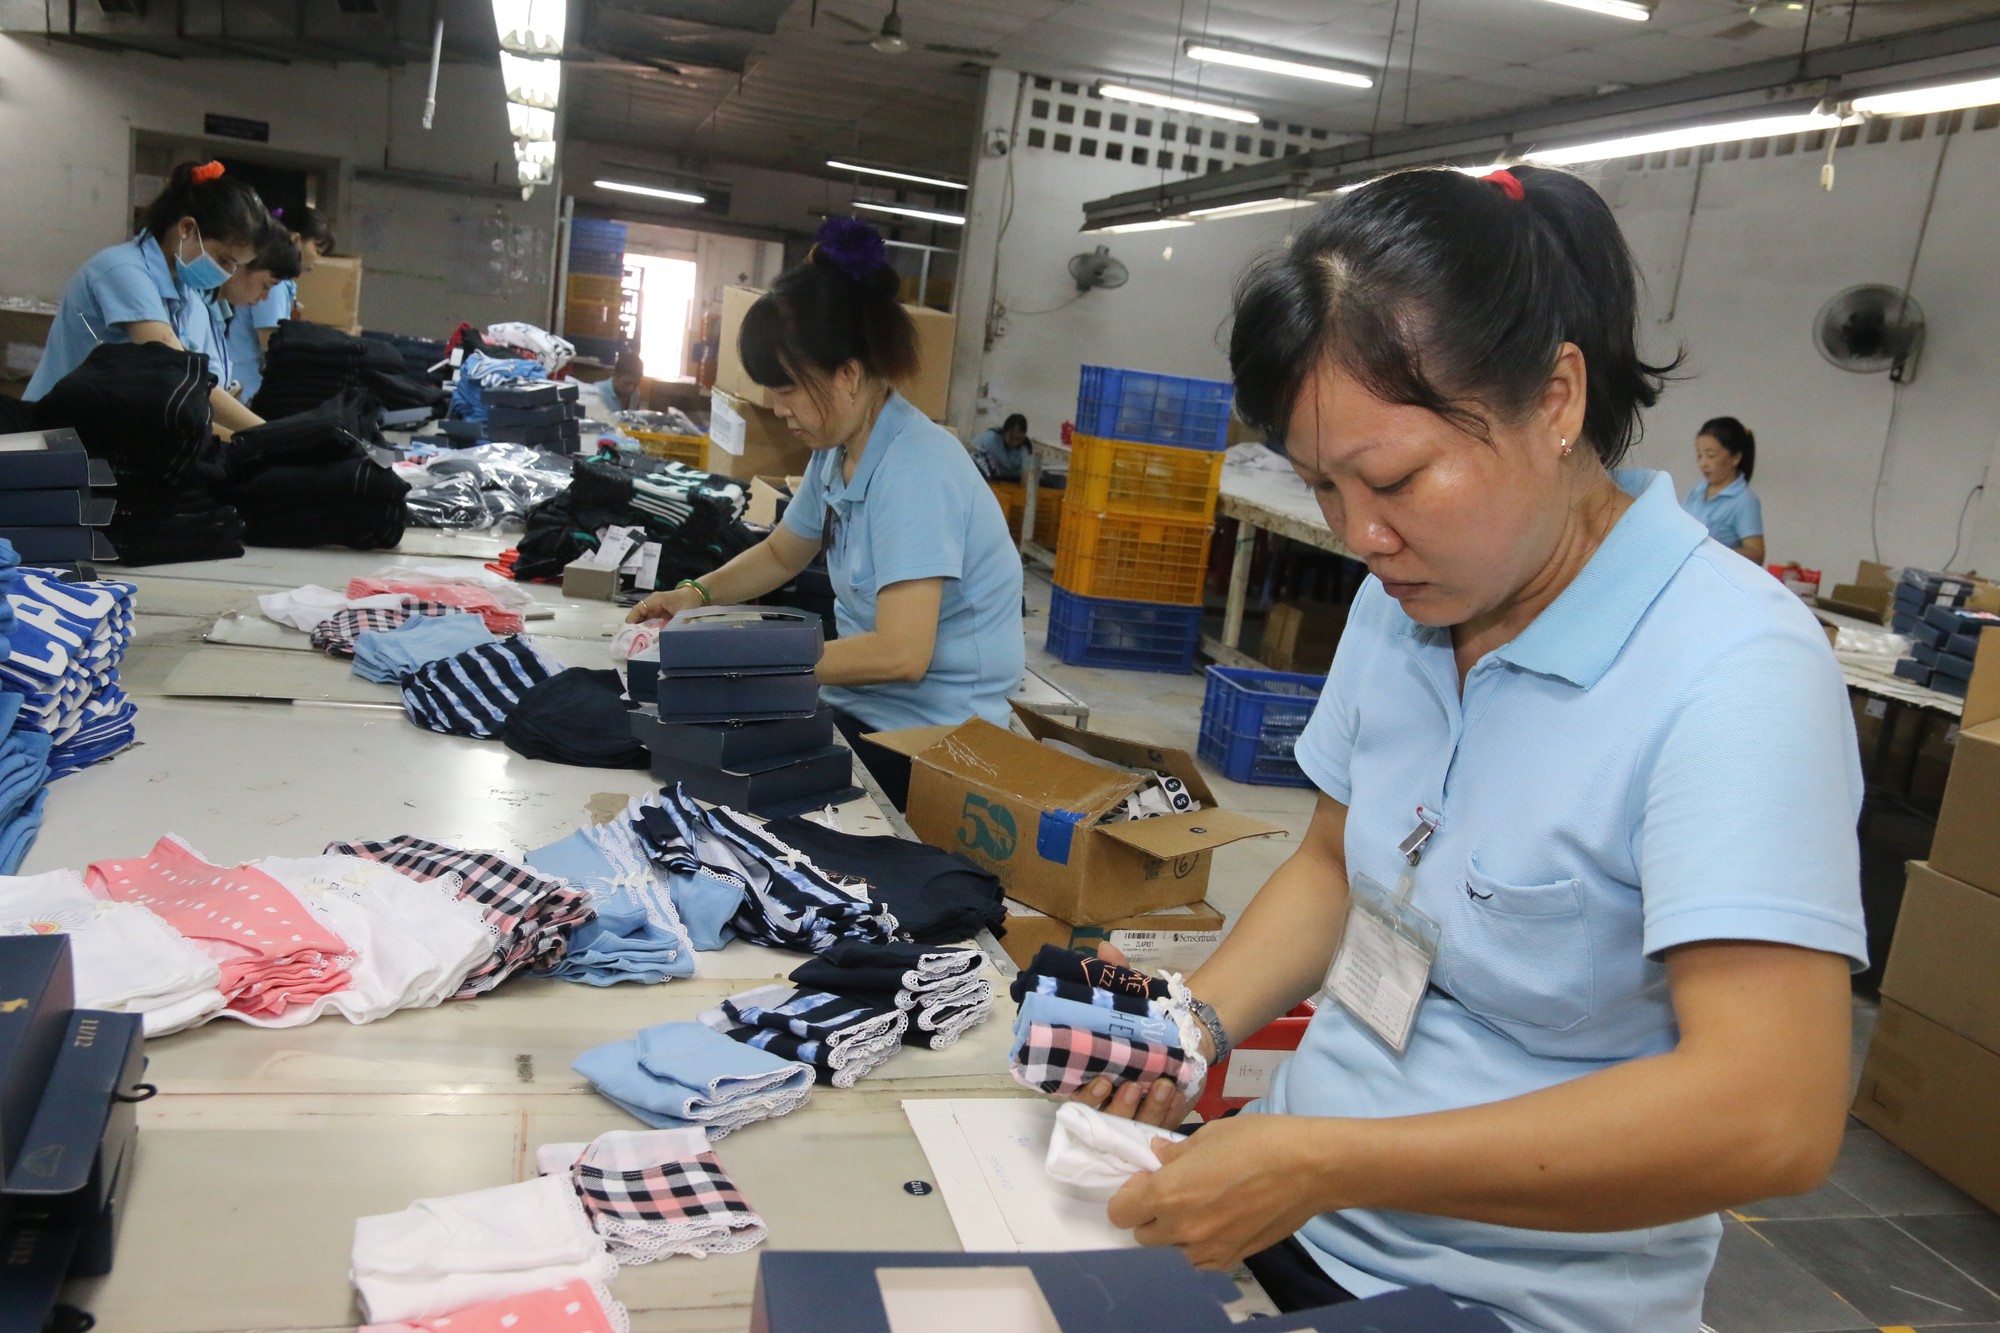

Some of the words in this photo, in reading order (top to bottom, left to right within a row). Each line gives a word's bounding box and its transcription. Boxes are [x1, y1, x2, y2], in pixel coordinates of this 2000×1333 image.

[1180, 933, 1218, 943] Sensormatic
[1100, 963, 1117, 988] IZZ
[74, 1019, 99, 1048] 11/12
